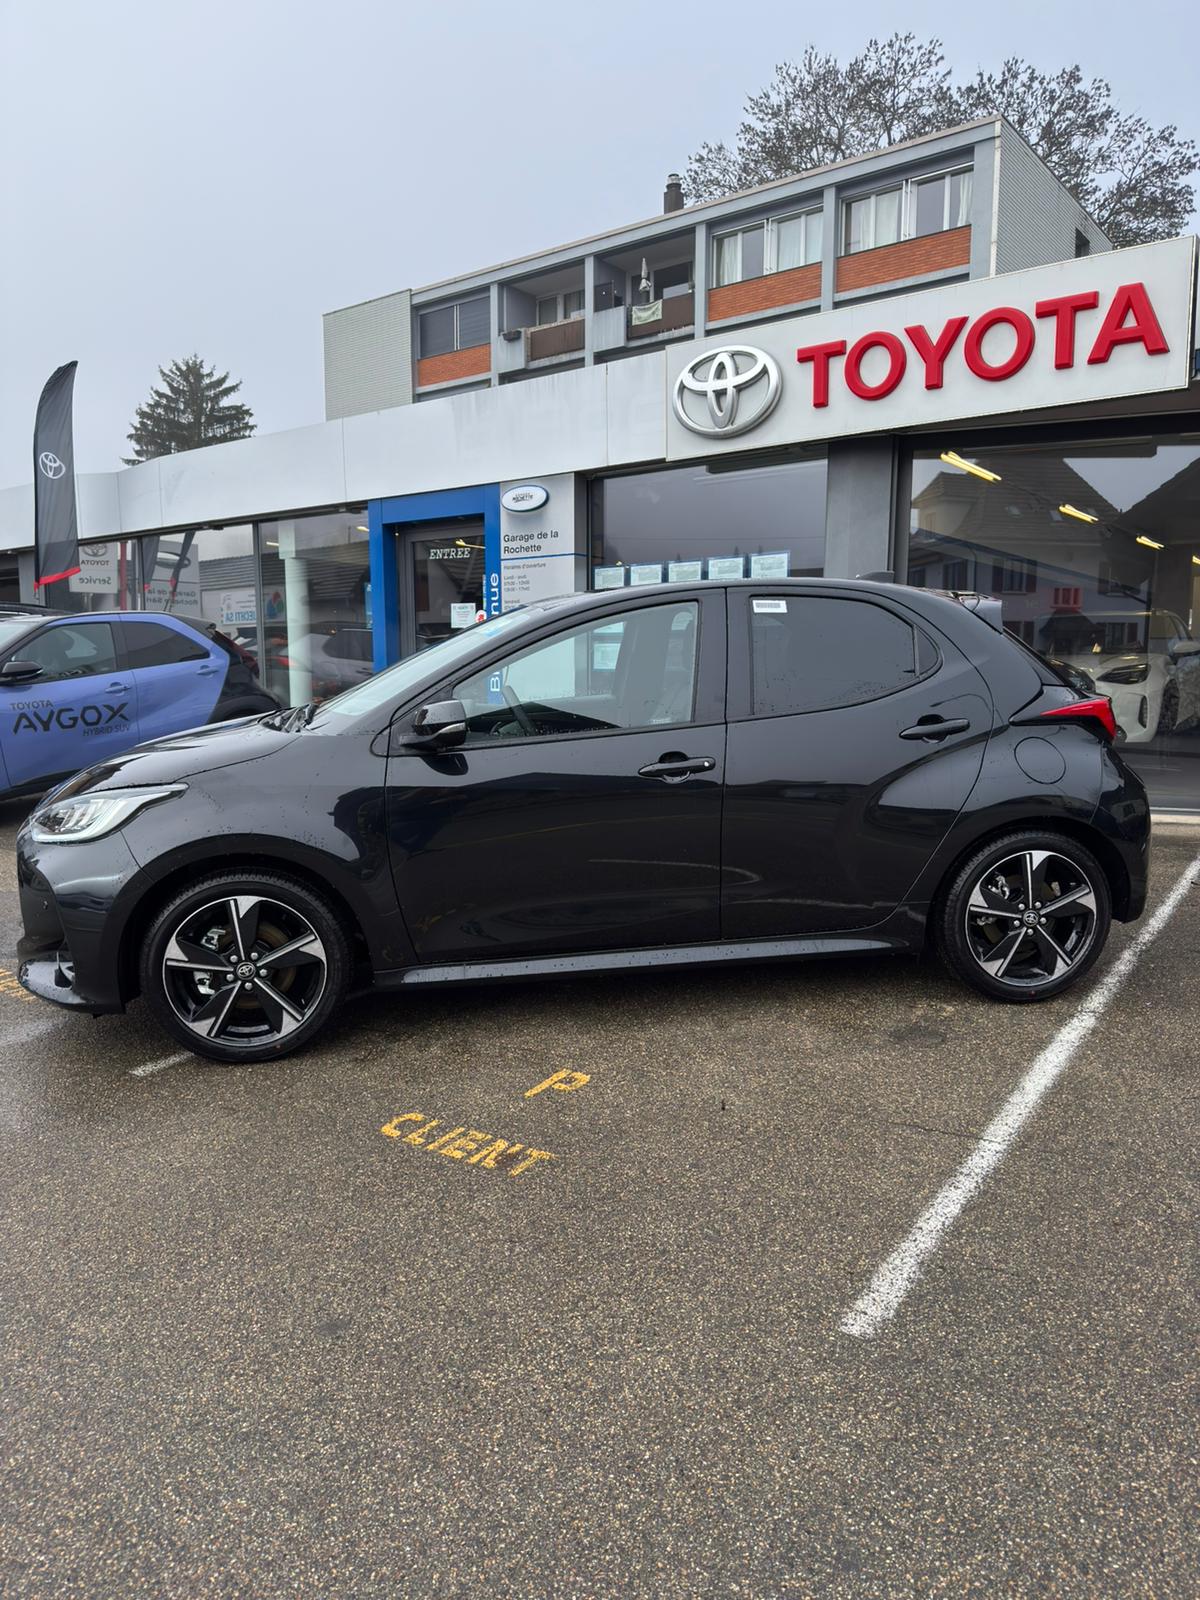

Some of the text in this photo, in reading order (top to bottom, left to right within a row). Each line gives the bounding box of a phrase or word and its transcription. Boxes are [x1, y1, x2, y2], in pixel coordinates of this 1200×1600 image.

[797, 281, 1170, 409] TOYOTA
[503, 530, 559, 543] Garage de la
[429, 547, 471, 560] ENTREE
[503, 544, 542, 554] Rochette
[10, 699, 54, 711] TOYOTA
[524, 1068, 591, 1098] P
[381, 1112, 561, 1177] CLIENT
